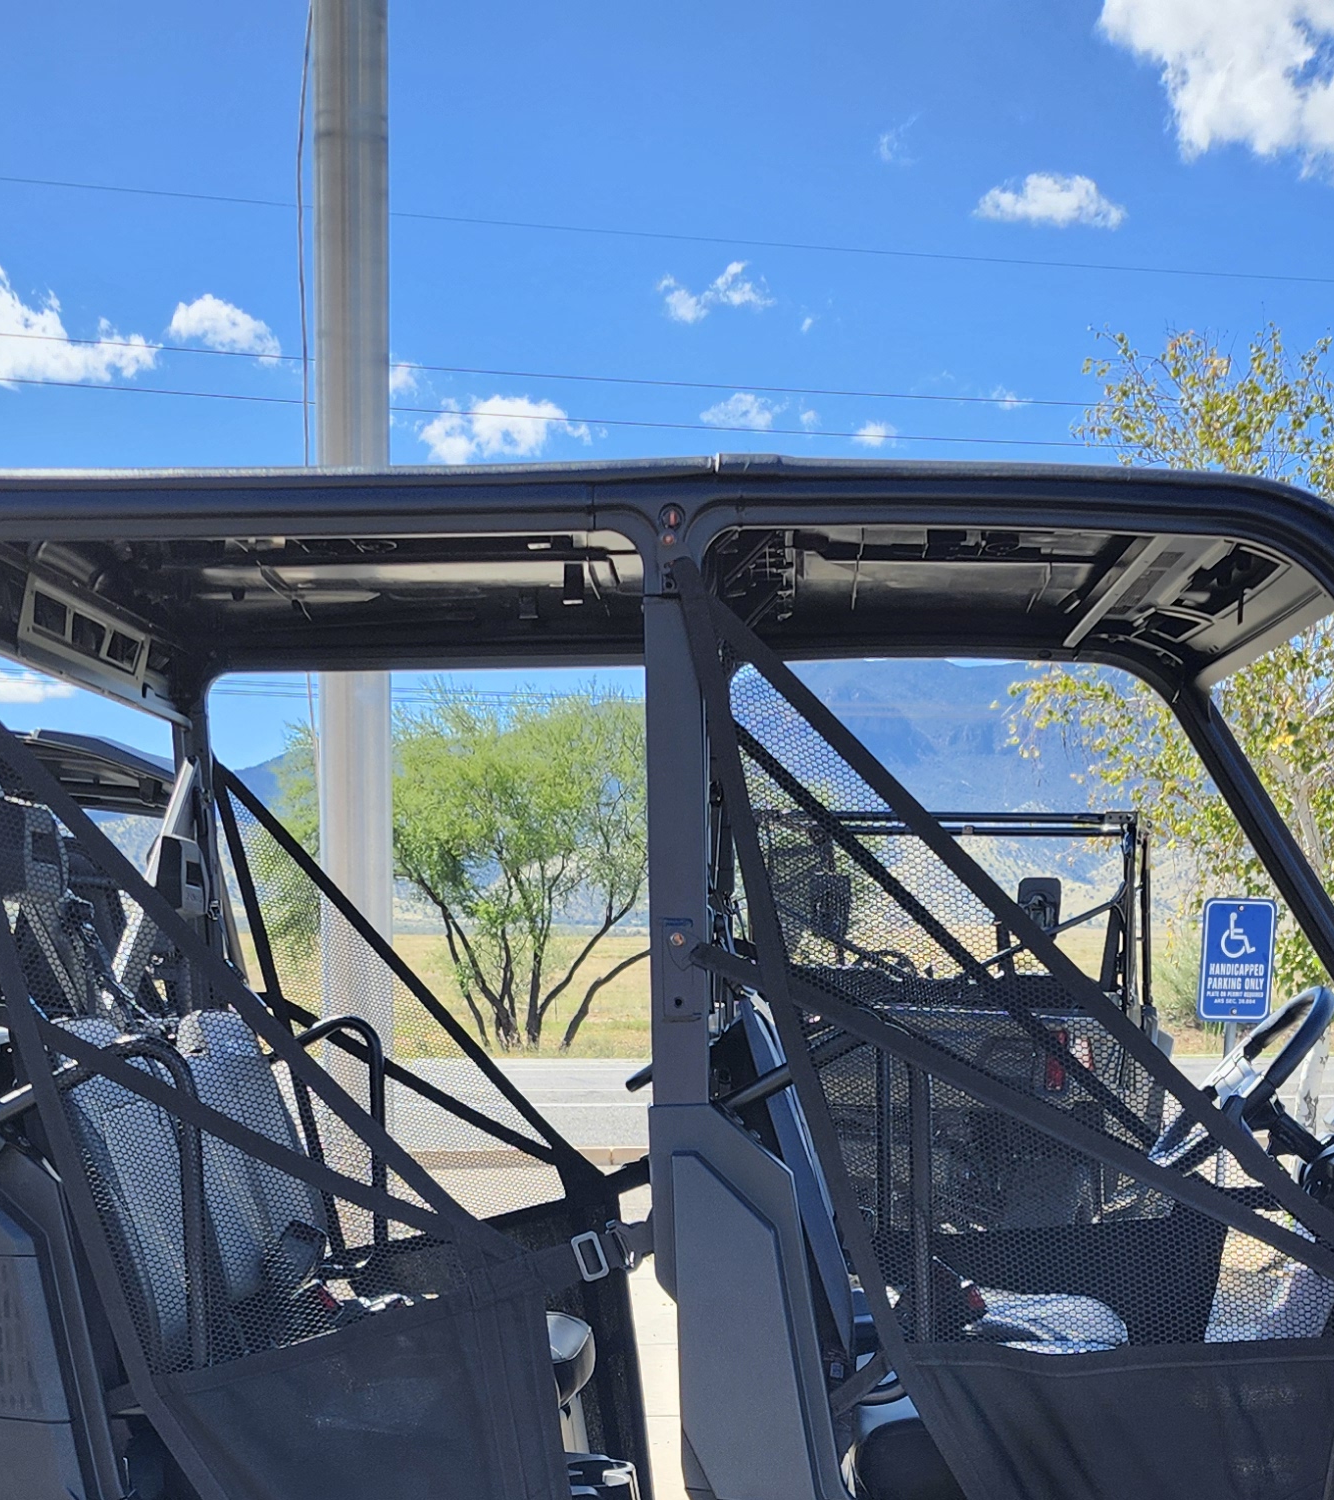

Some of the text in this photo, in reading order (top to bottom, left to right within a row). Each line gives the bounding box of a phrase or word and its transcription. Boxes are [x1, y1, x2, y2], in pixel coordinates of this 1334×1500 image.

[1209, 963, 1265, 976] HANDICAPPED
[1207, 977, 1264, 990] PARKING ONLY
